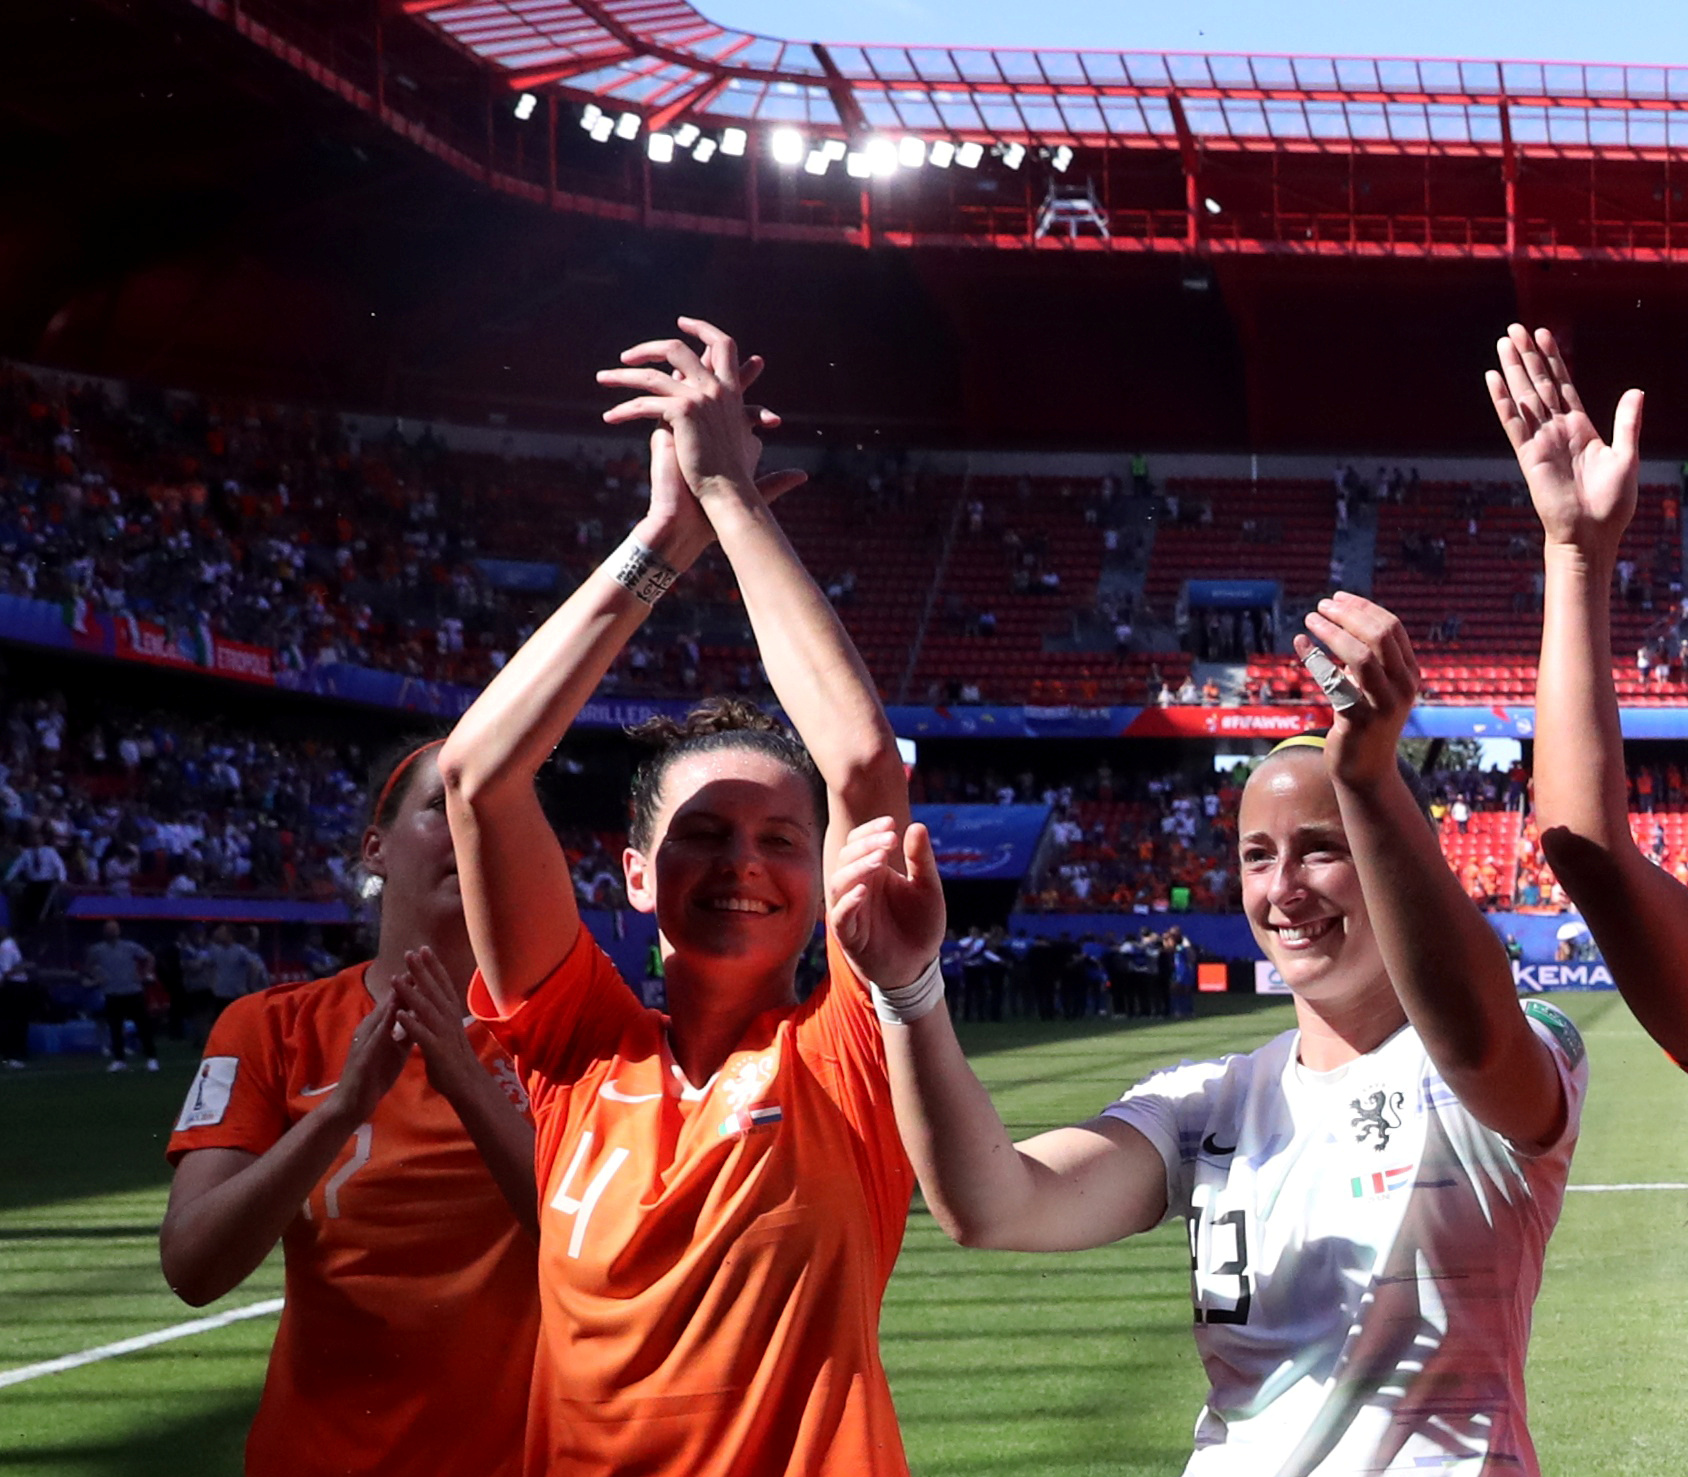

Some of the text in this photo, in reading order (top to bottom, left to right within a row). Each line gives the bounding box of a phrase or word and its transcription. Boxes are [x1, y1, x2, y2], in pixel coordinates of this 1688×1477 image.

[1514, 964, 1613, 991] KEMA
[302, 1123, 373, 1220] 7
[550, 1131, 629, 1260] 4
